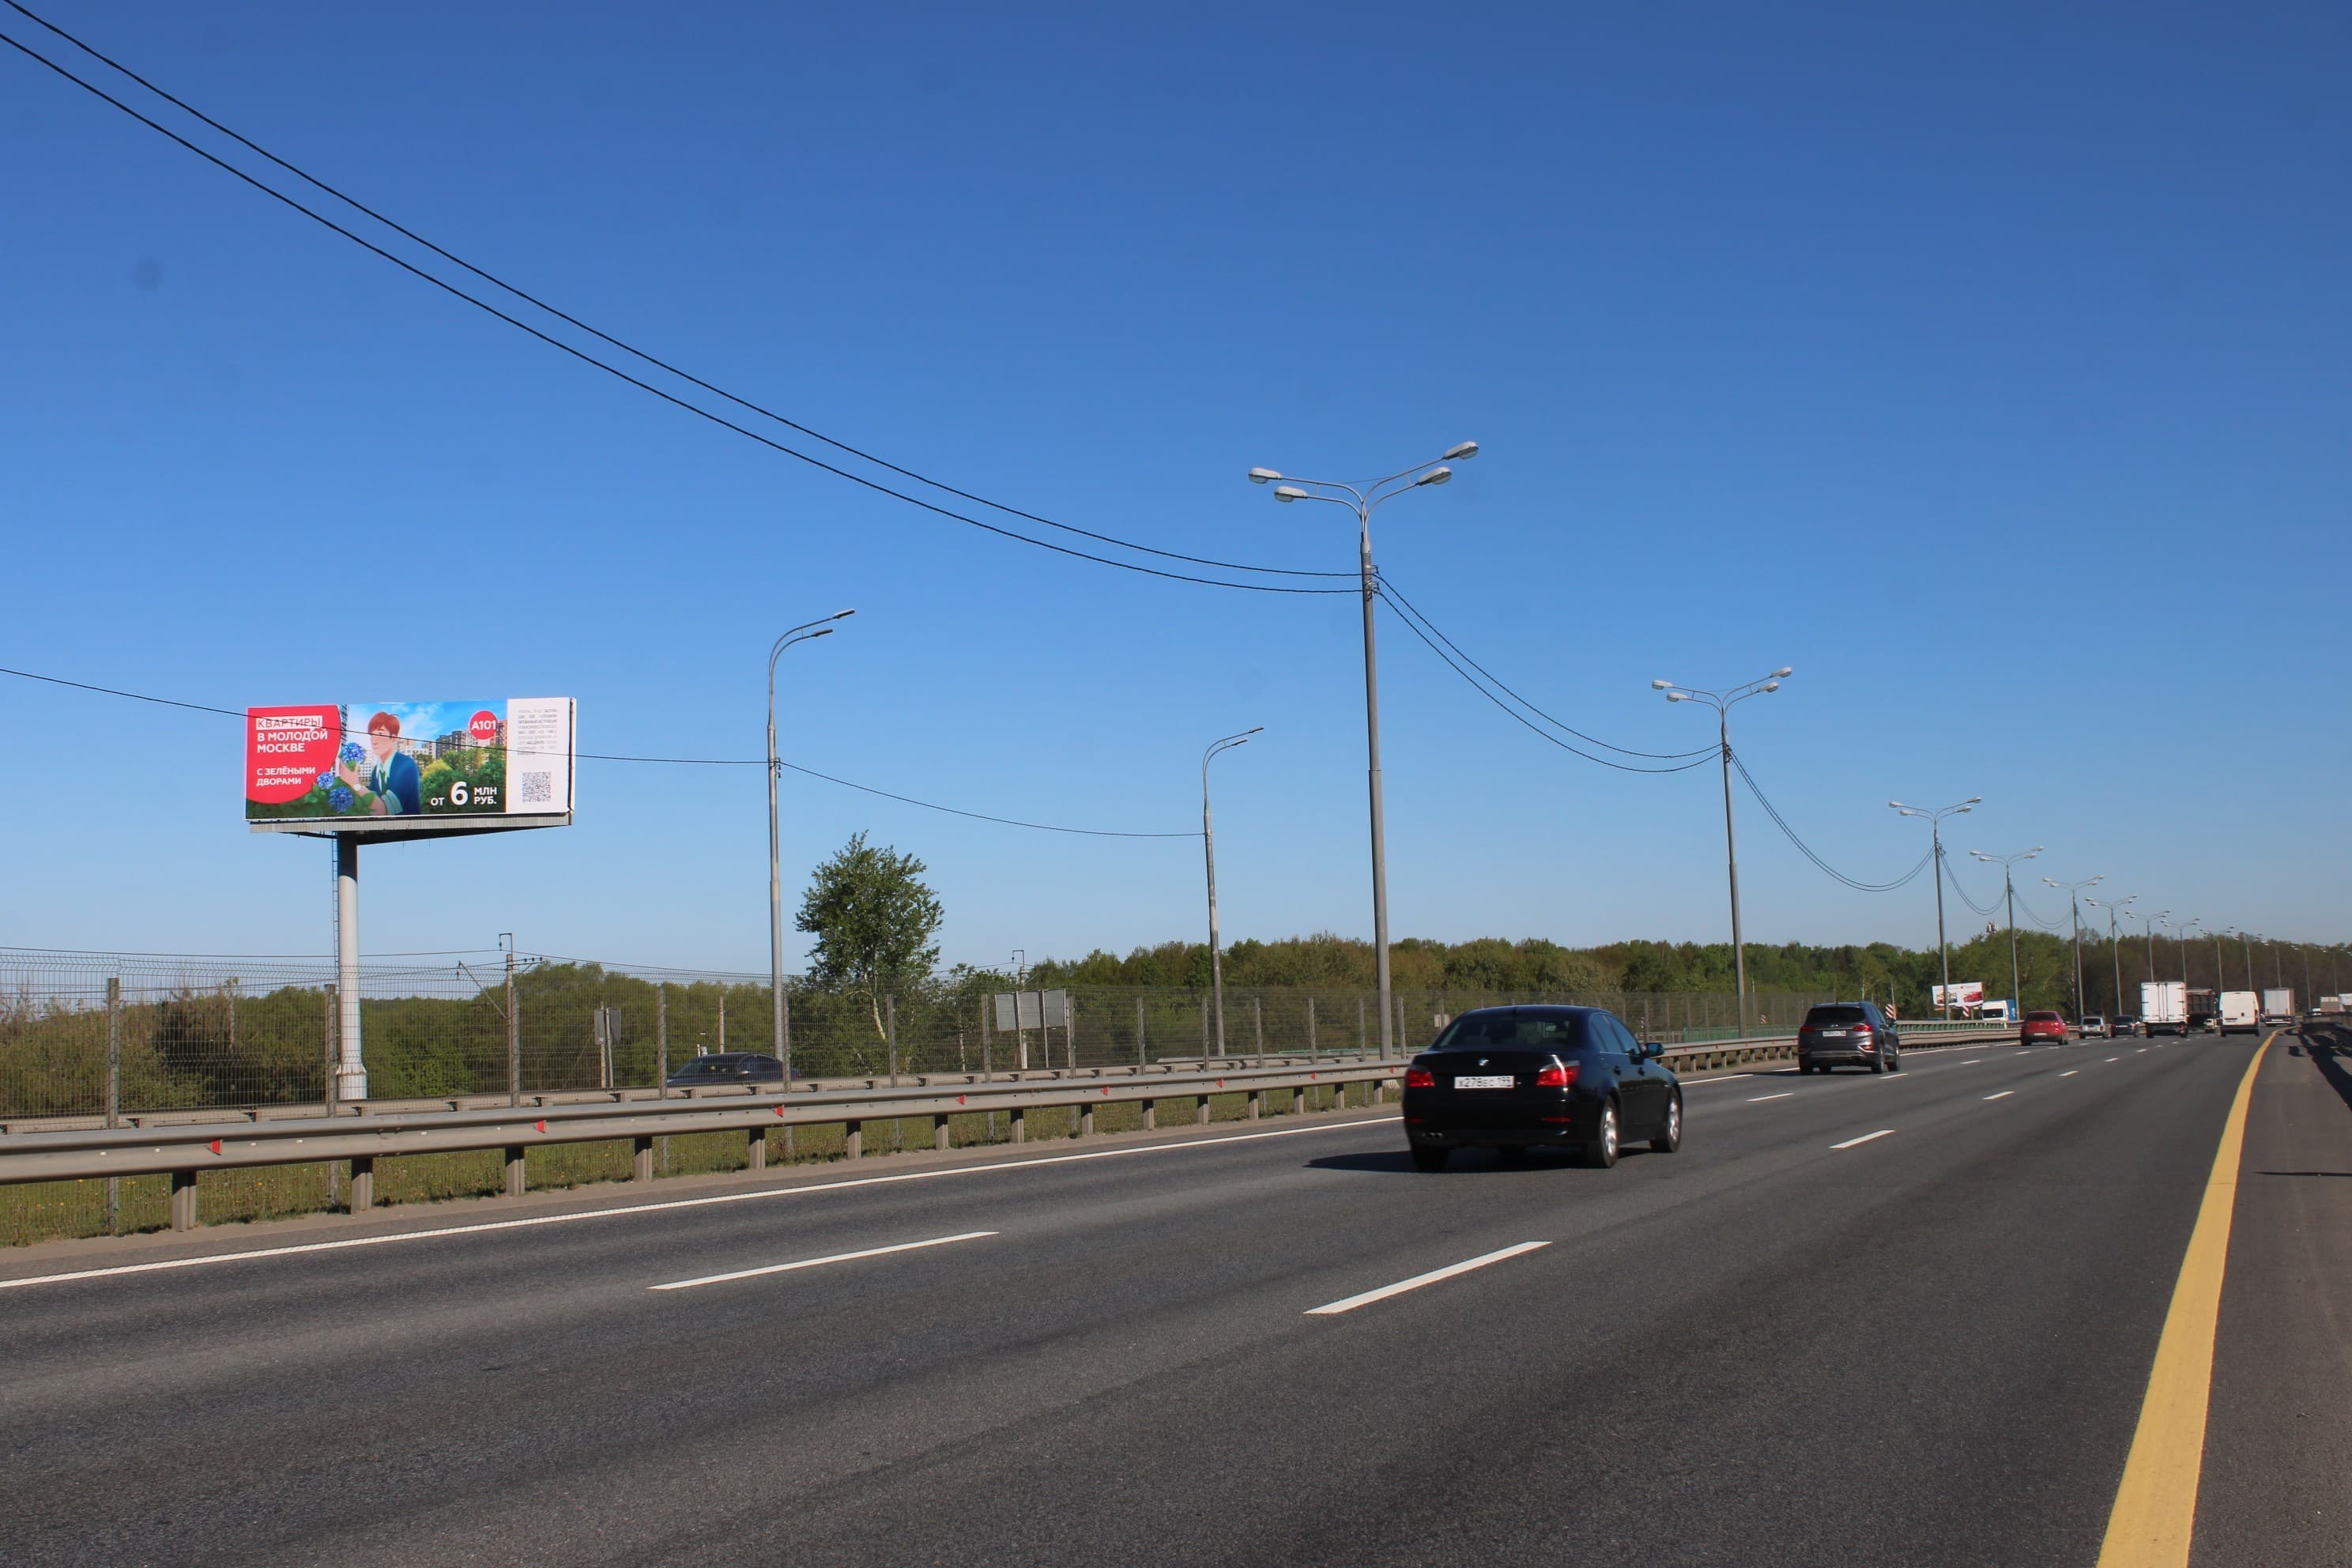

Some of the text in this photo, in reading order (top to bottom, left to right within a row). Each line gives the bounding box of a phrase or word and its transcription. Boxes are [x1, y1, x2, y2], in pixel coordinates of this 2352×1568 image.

[258, 717, 321, 728] КВАРТИРЫ
[471, 720, 496, 730] А101
[257, 729, 328, 741] В МОЛОДОЙ
[257, 743, 305, 753] МОСКВЕ
[265, 766, 315, 775] ЗЕЛЁНЫМИ
[256, 777, 302, 787] ДВОРАМИ
[450, 781, 469, 805] 6
[473, 786, 497, 795] МЛН
[473, 796, 497, 805] РУБ.
